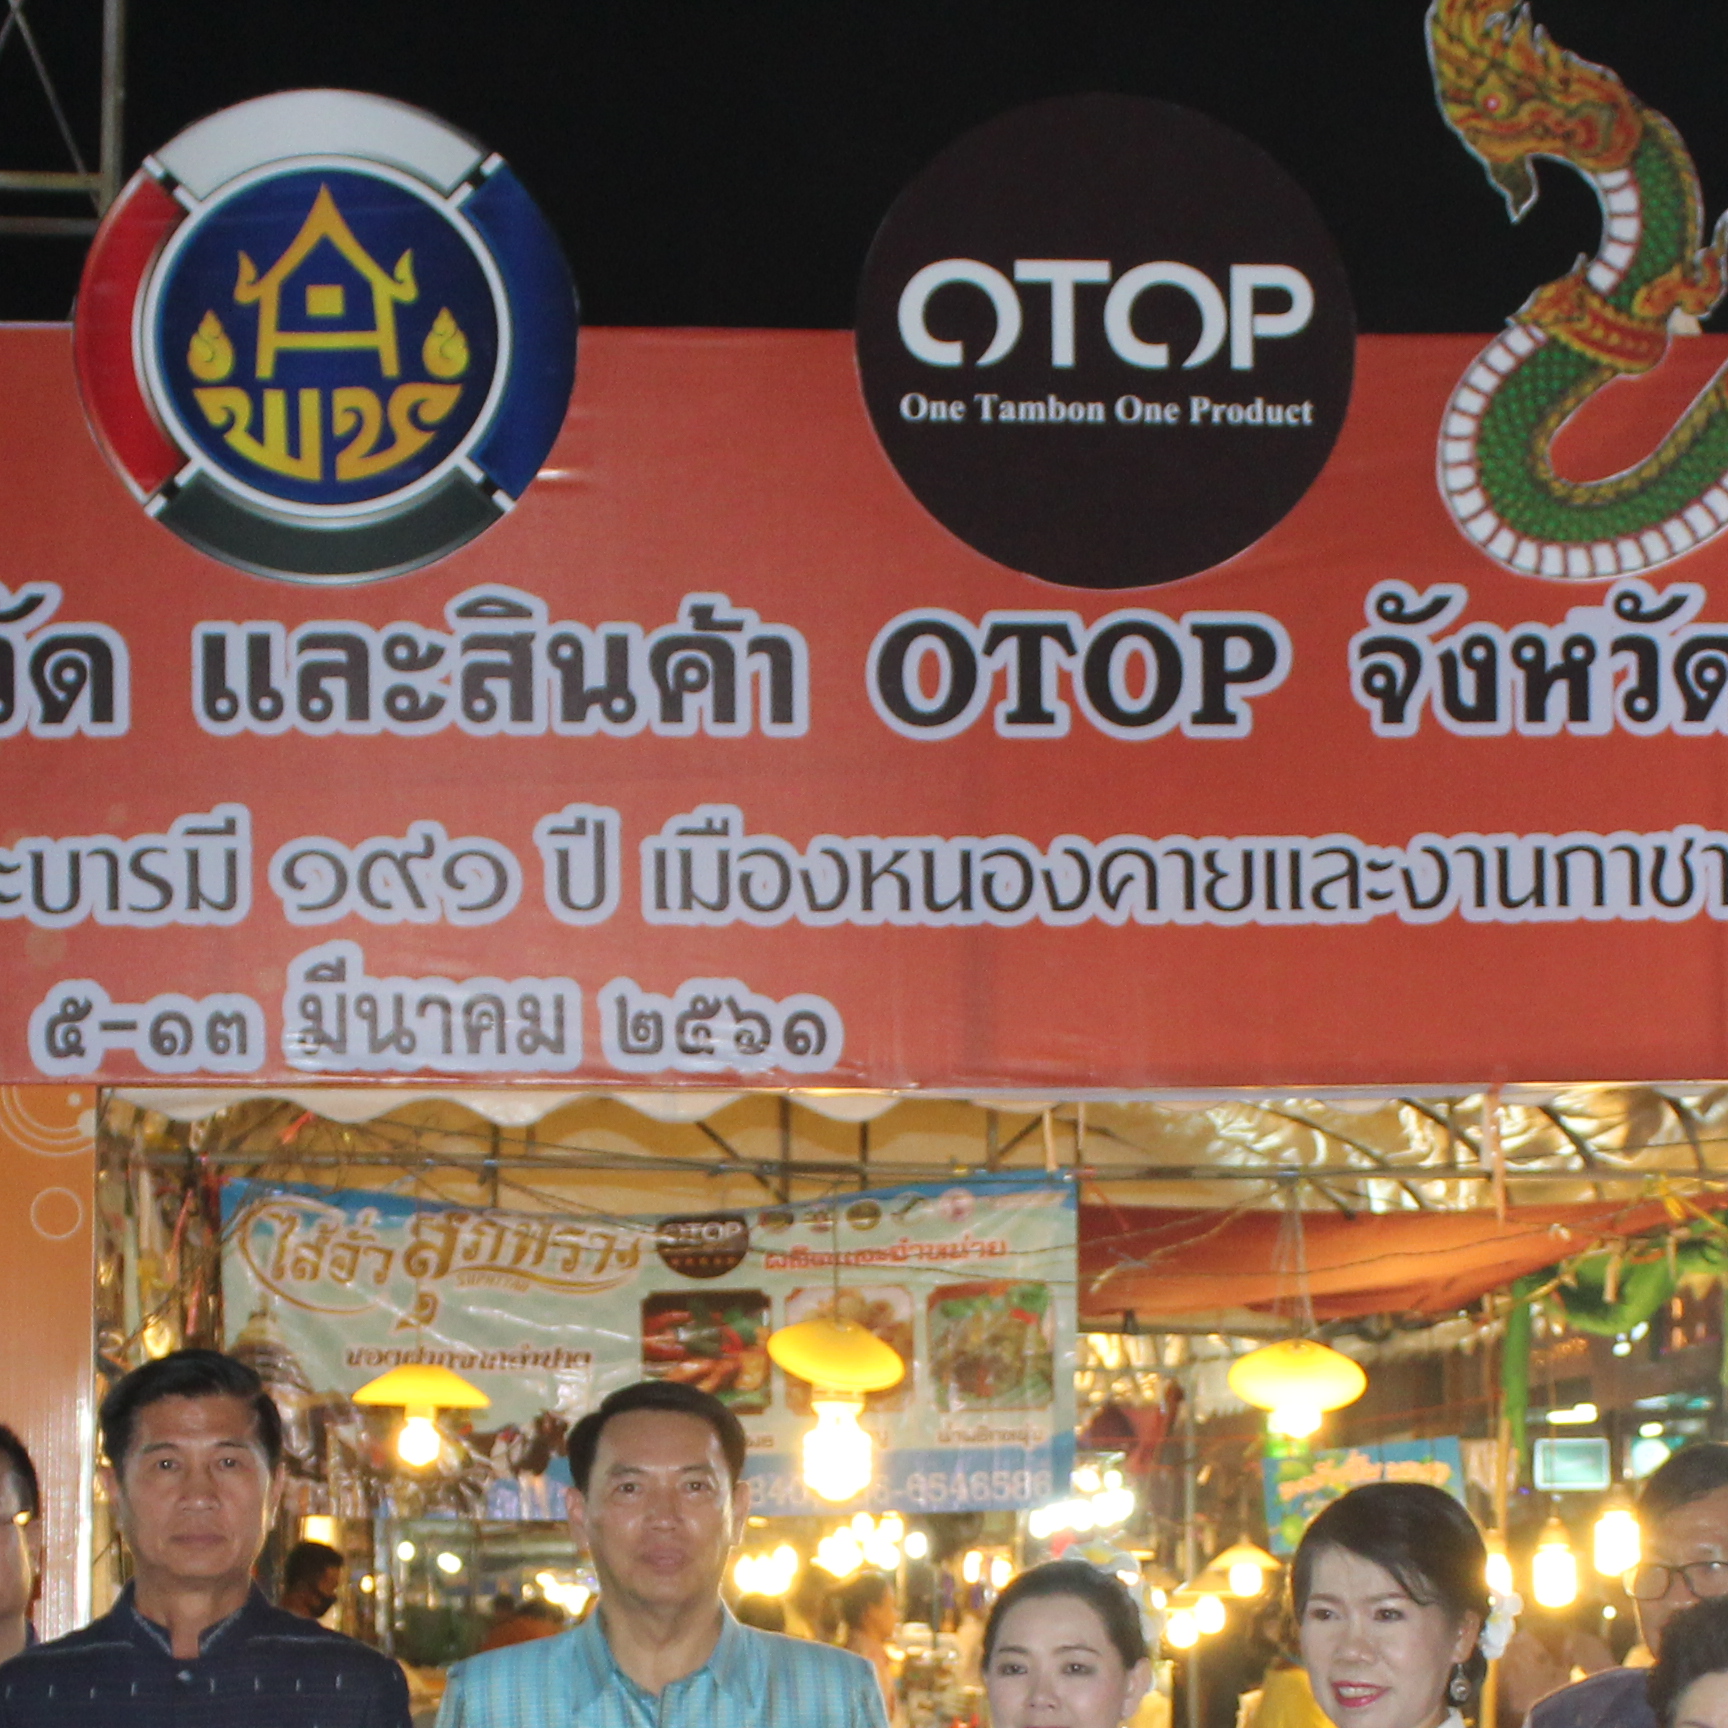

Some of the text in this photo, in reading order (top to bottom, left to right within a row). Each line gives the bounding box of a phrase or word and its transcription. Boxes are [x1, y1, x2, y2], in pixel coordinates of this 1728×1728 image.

[898, 258, 1315, 370] OTOP
[900, 392, 1314, 427] One Tambon One Product
[199, 596, 794, 724] และสินค้า
[877, 618, 1277, 727] OTOP
[281, 822, 509, 912] ๑๙๑
[549, 818, 609, 913] ปี
[44, 958, 829, 1059] ๕-๑๓ มีนาคม ๒๕๖๑
